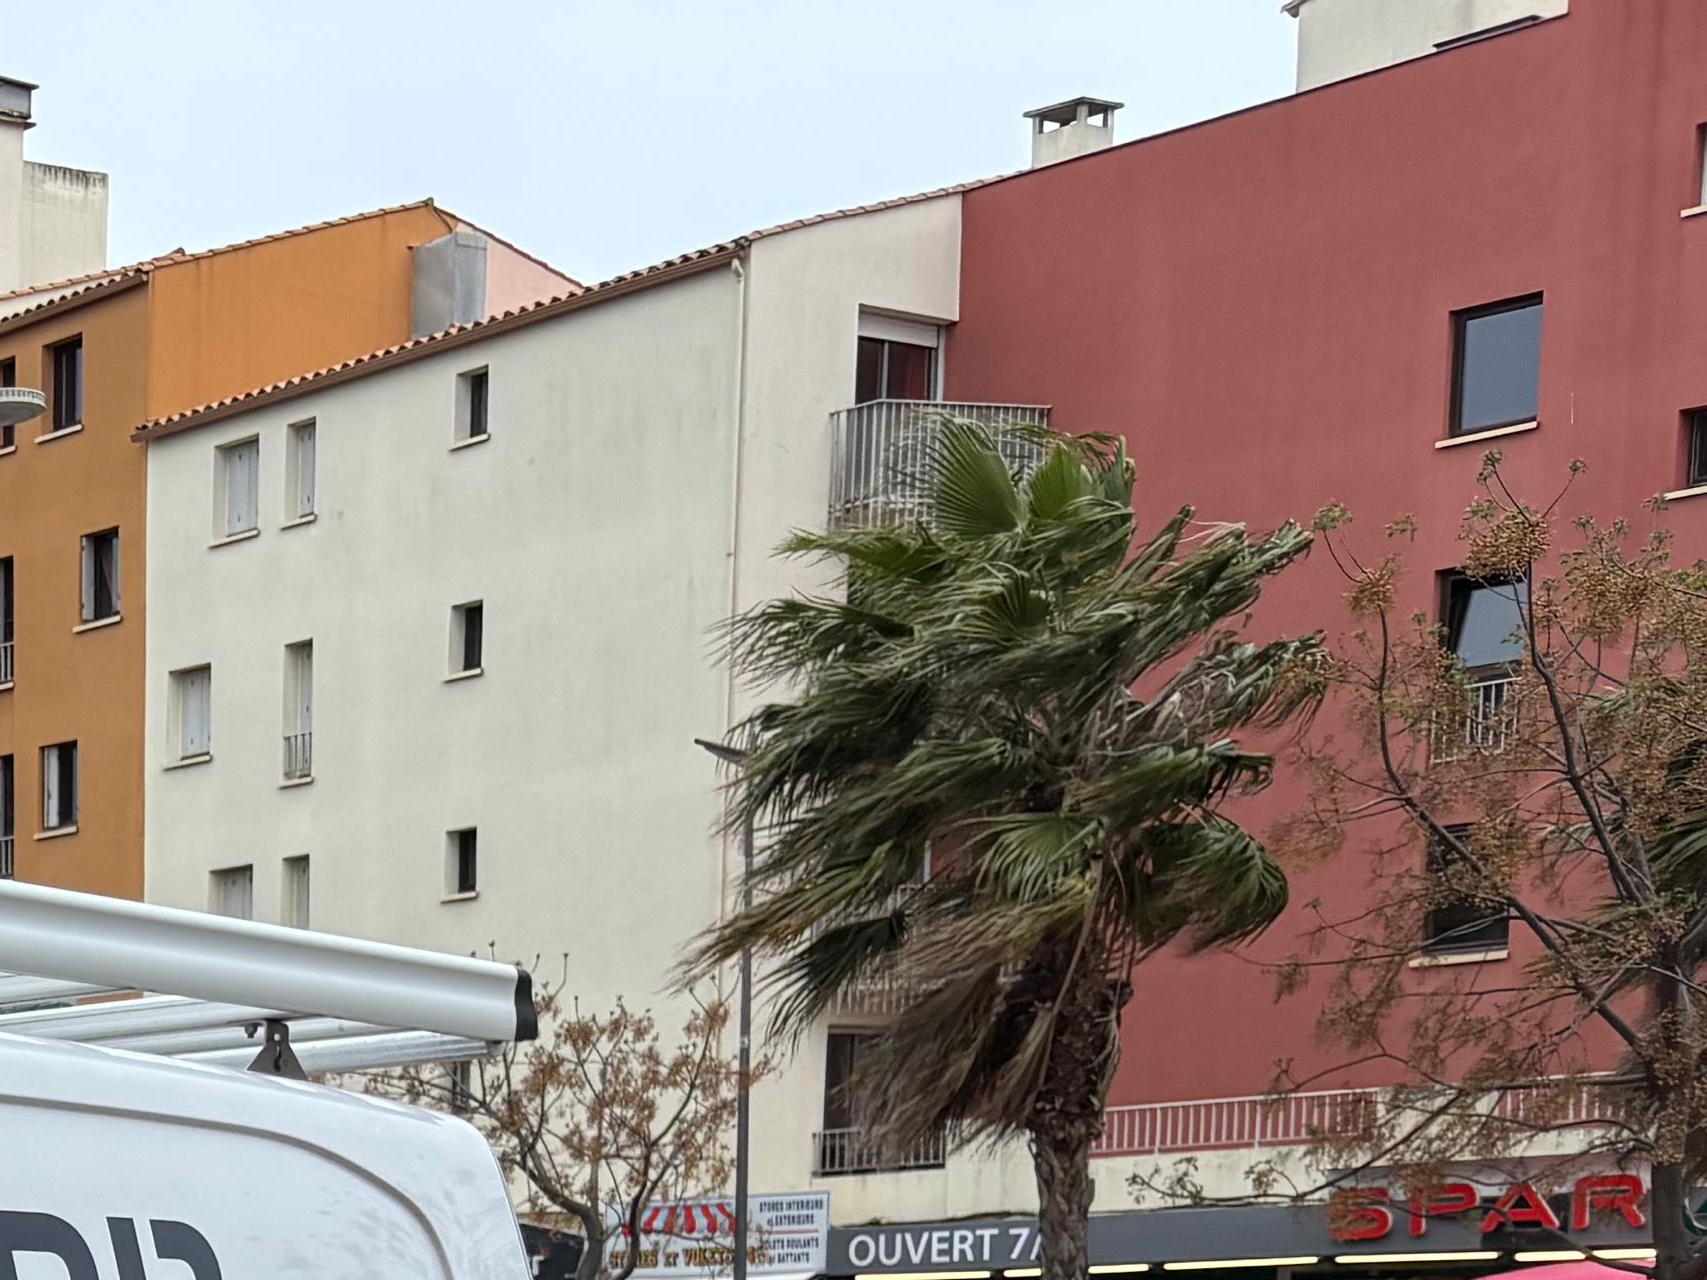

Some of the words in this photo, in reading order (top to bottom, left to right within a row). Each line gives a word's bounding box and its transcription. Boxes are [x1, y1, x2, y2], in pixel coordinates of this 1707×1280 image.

[1329, 1174, 1646, 1242] SPAR
[848, 1228, 1000, 1267] OUVERT
[1008, 1227, 1042, 1262] 7/
